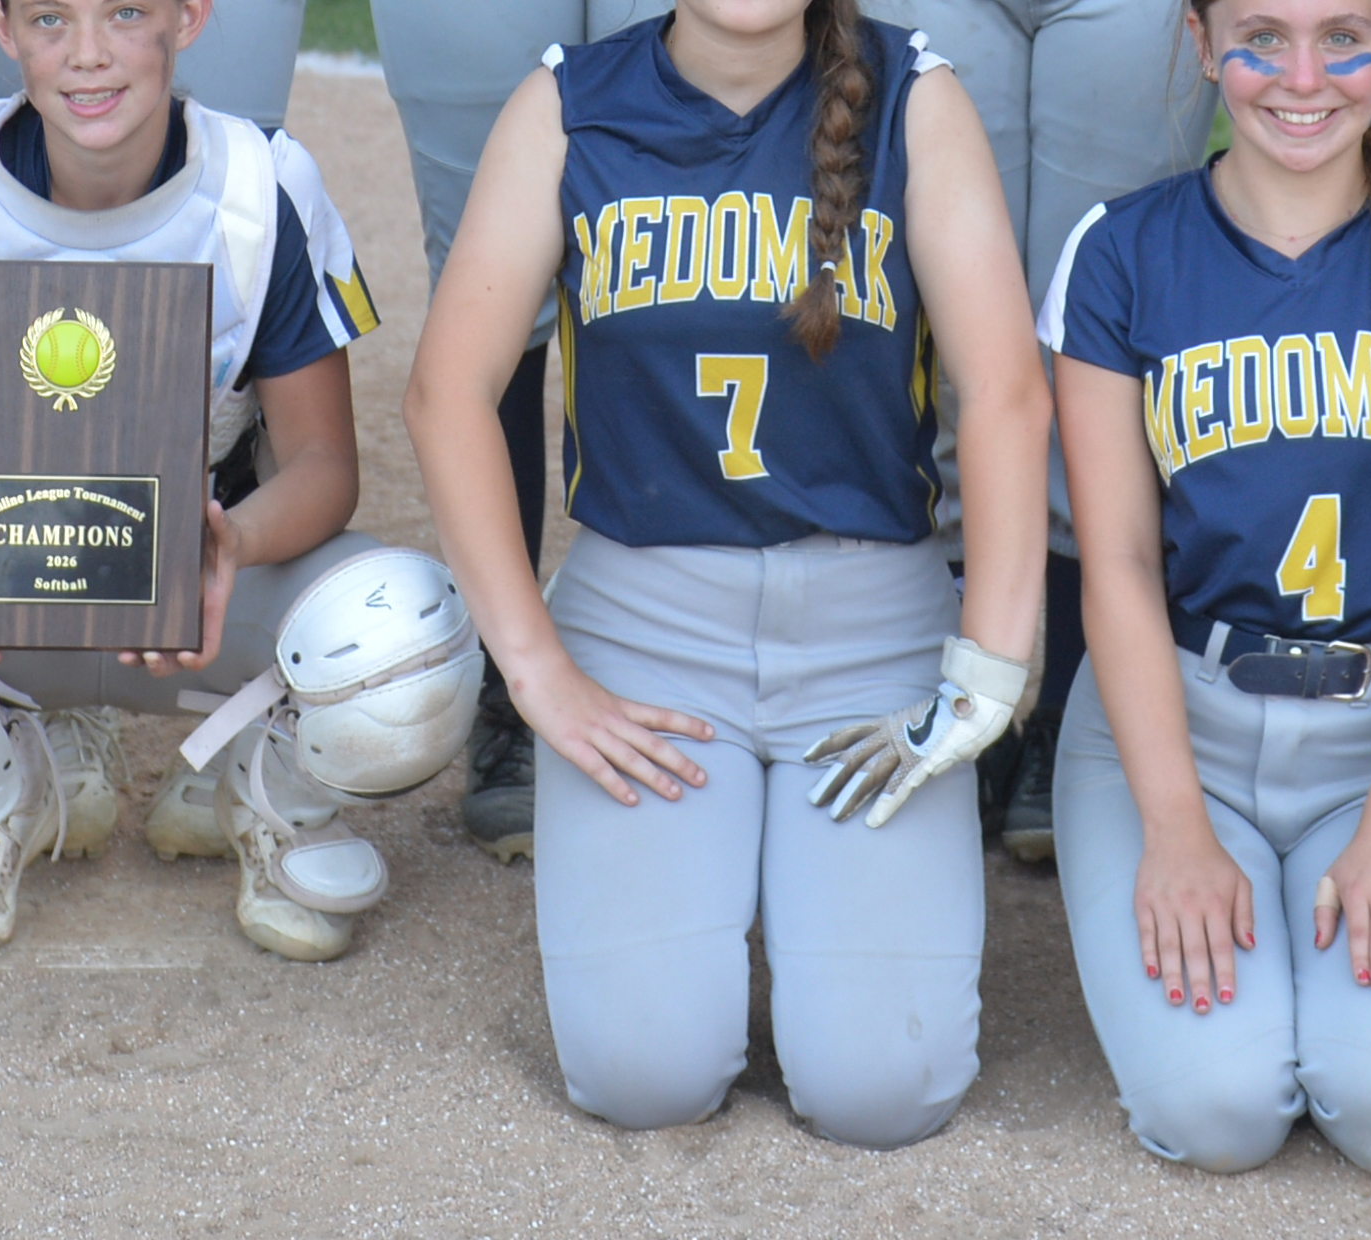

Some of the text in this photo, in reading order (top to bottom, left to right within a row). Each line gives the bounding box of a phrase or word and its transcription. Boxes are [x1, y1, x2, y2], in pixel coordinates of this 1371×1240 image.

[695, 353, 770, 480] 7
[26, 487, 71, 502] League
[73, 486, 146, 523] Tournament
[46, 555, 78, 568] 2026
[1276, 493, 1346, 621] 4
[34, 577, 88, 592] Softball
